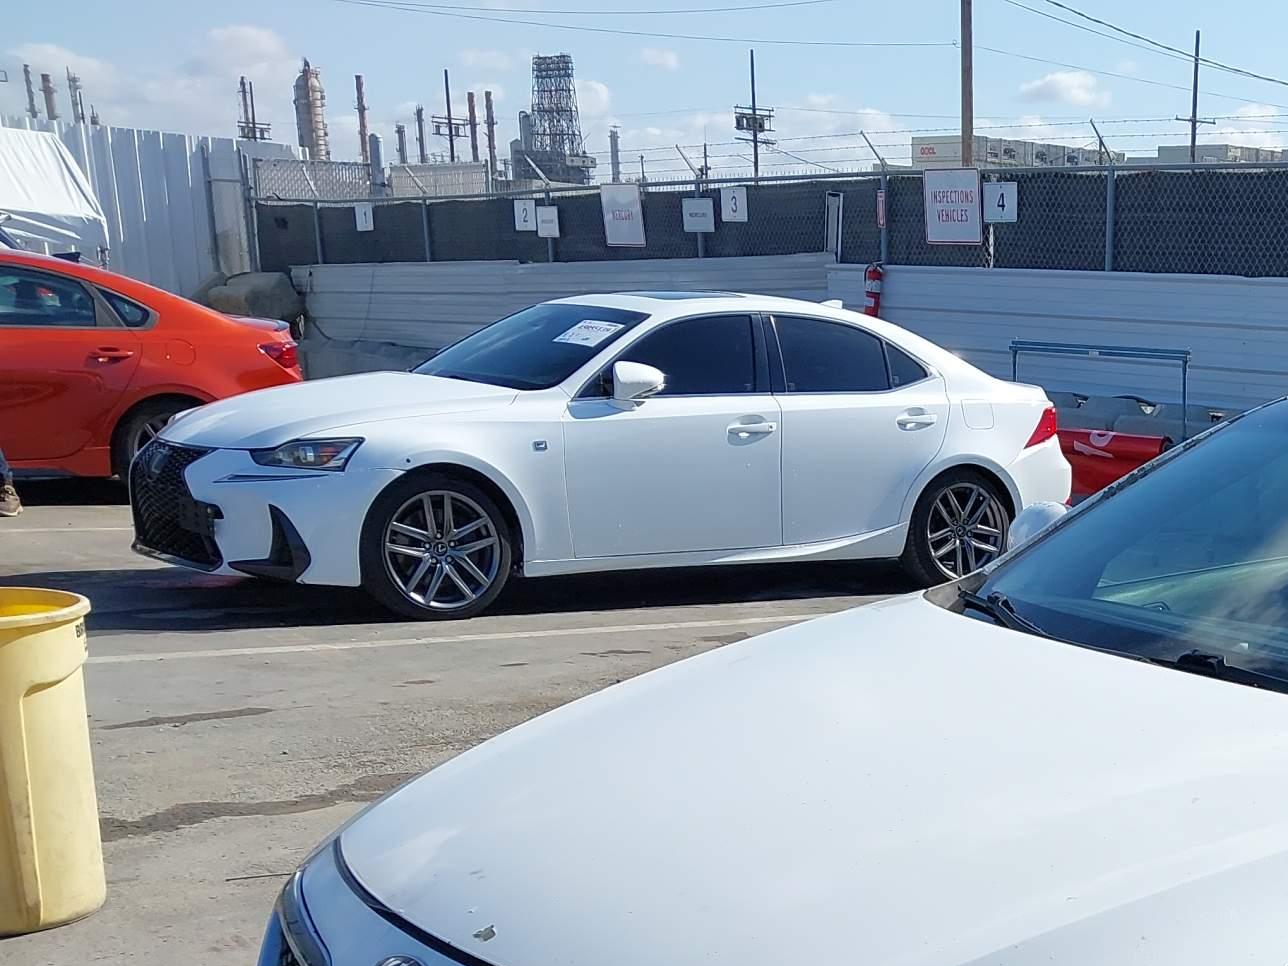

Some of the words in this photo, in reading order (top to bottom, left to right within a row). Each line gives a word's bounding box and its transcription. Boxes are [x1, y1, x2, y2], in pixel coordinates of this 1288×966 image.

[730, 195, 738, 213] 3
[930, 190, 974, 204] INSPECTIONS
[997, 192, 1006, 212] 4
[521, 207, 529, 223] 2
[936, 208, 969, 222] VEHICLES
